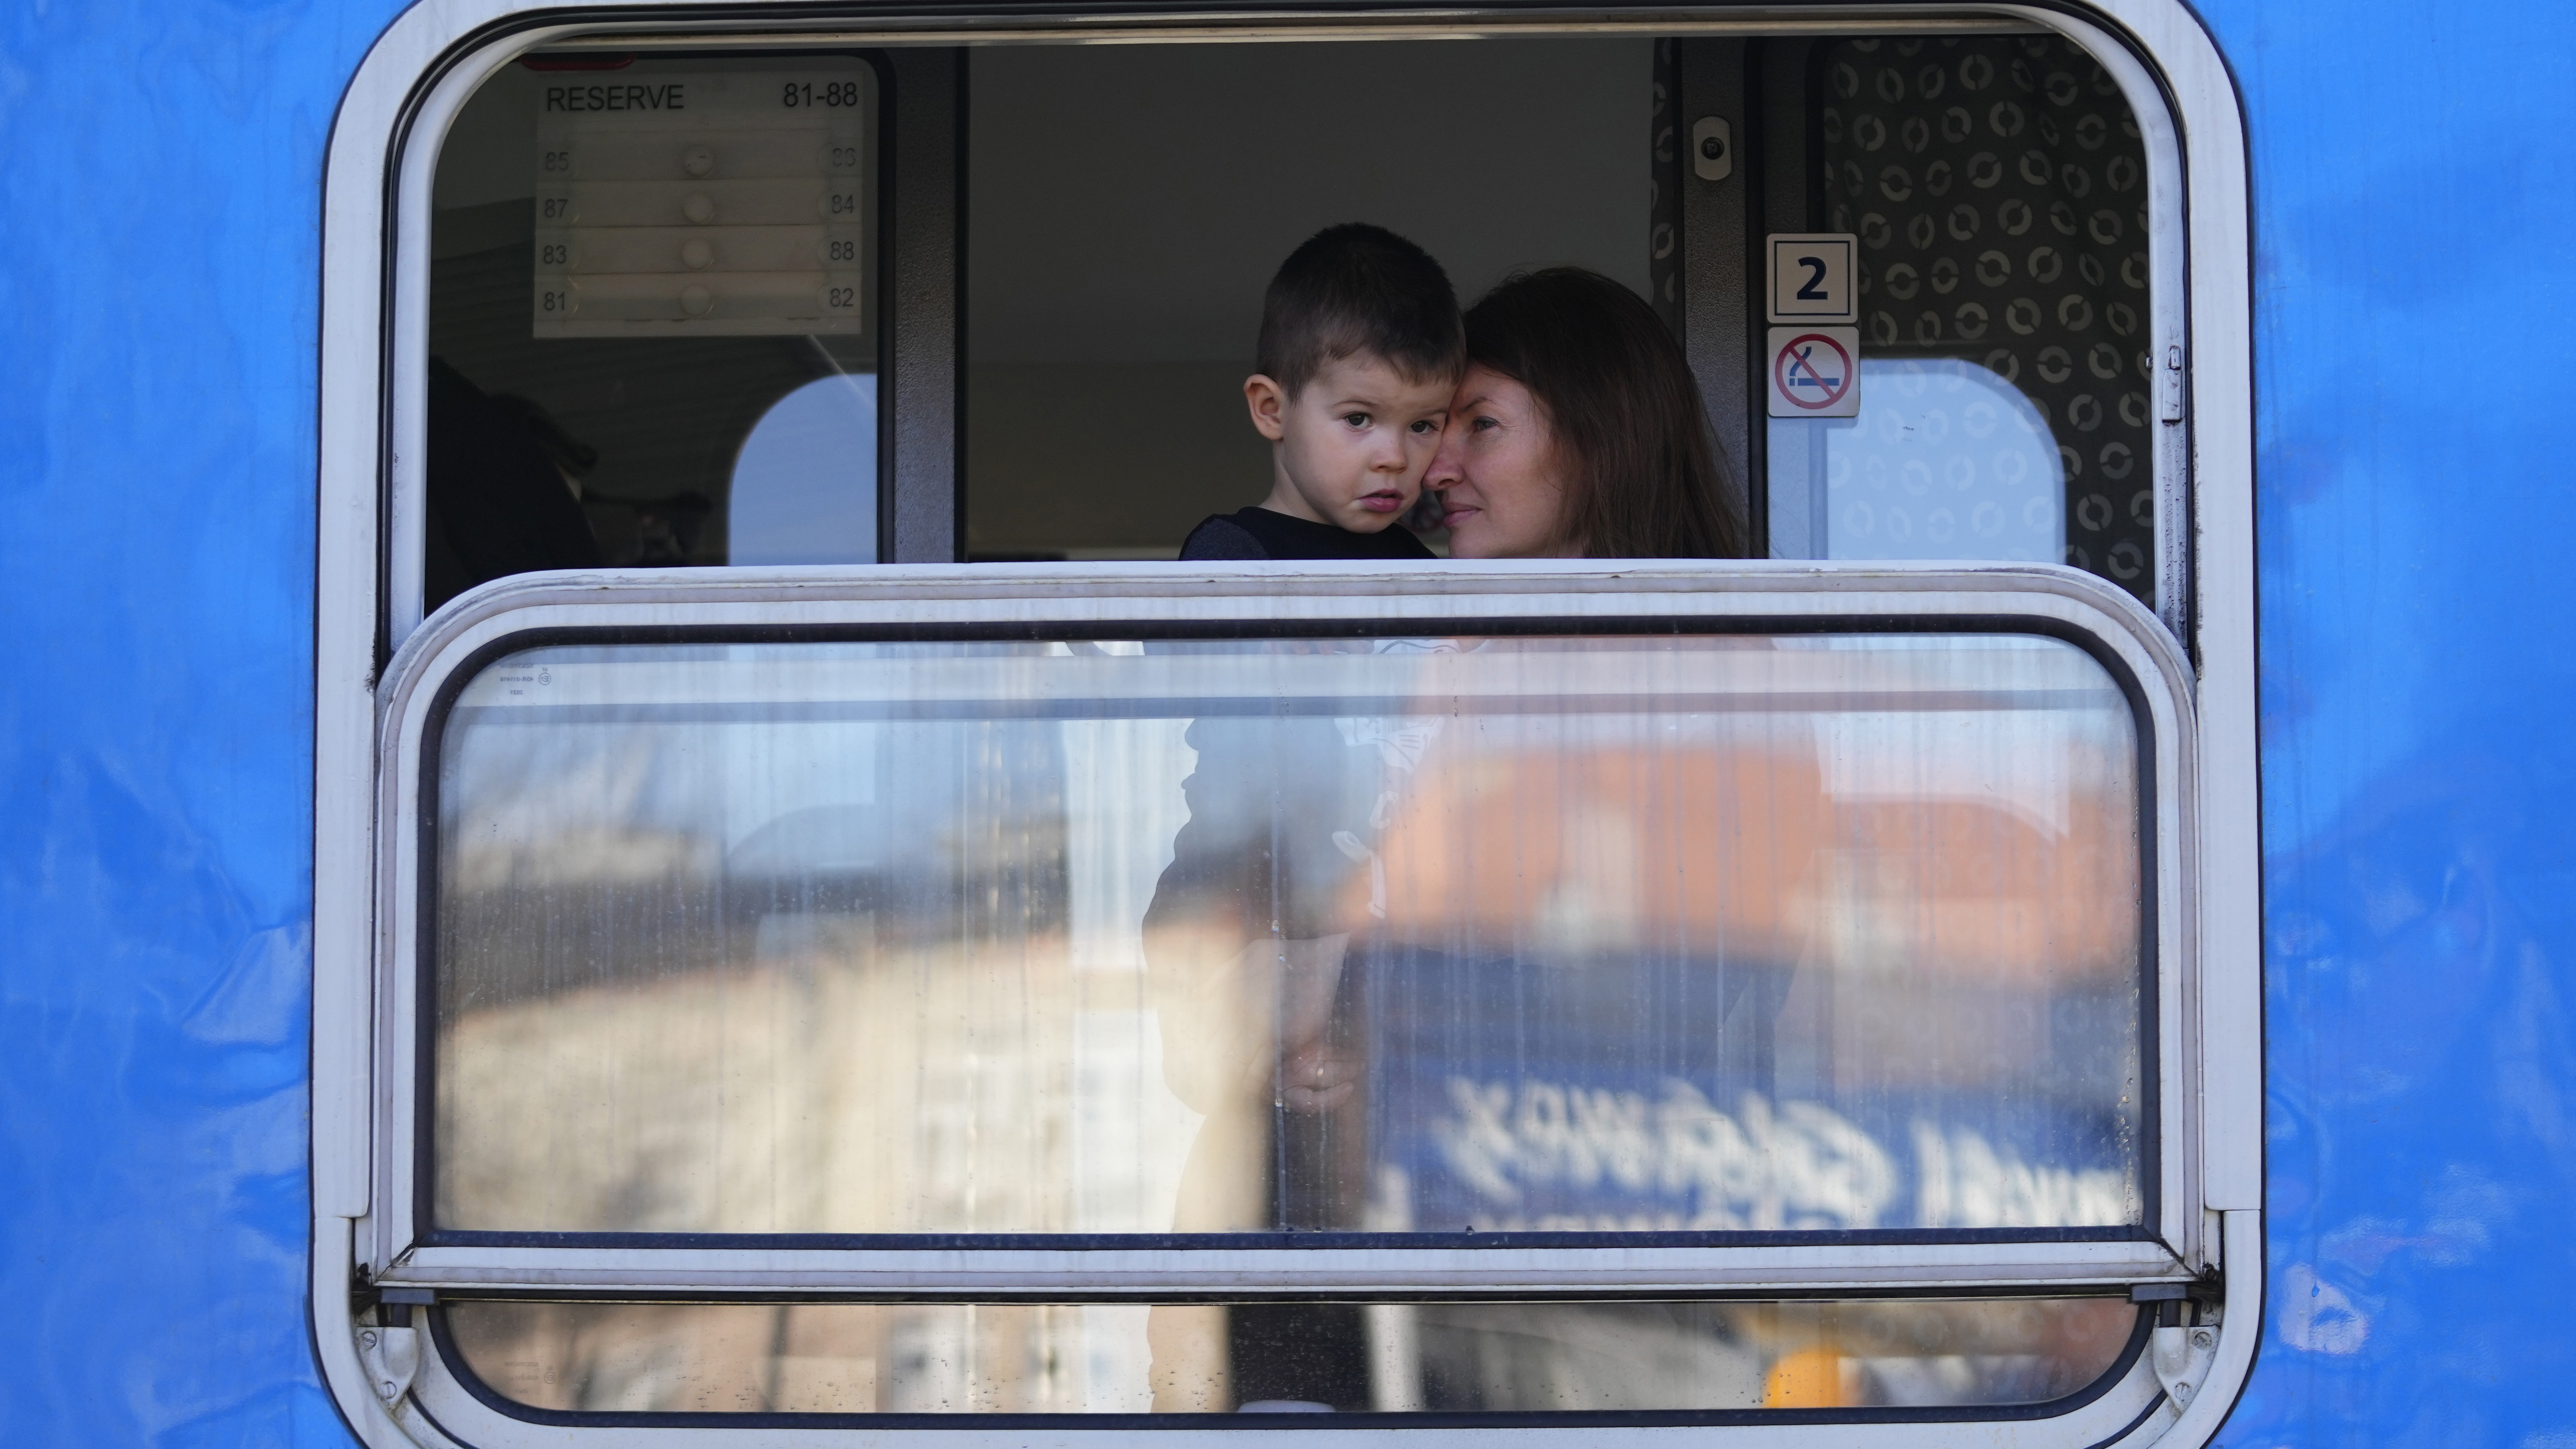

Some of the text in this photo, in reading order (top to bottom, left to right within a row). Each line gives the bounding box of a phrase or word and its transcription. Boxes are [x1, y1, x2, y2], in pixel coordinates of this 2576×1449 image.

[546, 82, 858, 112] RESERVE 81-88
[546, 152, 569, 171] 85
[544, 198, 569, 218] 87
[832, 194, 854, 214] 84
[543, 244, 567, 265] 83
[830, 241, 854, 260] 88
[1797, 256, 1828, 300] 2
[543, 291, 565, 312] 81
[830, 288, 854, 307] 82
